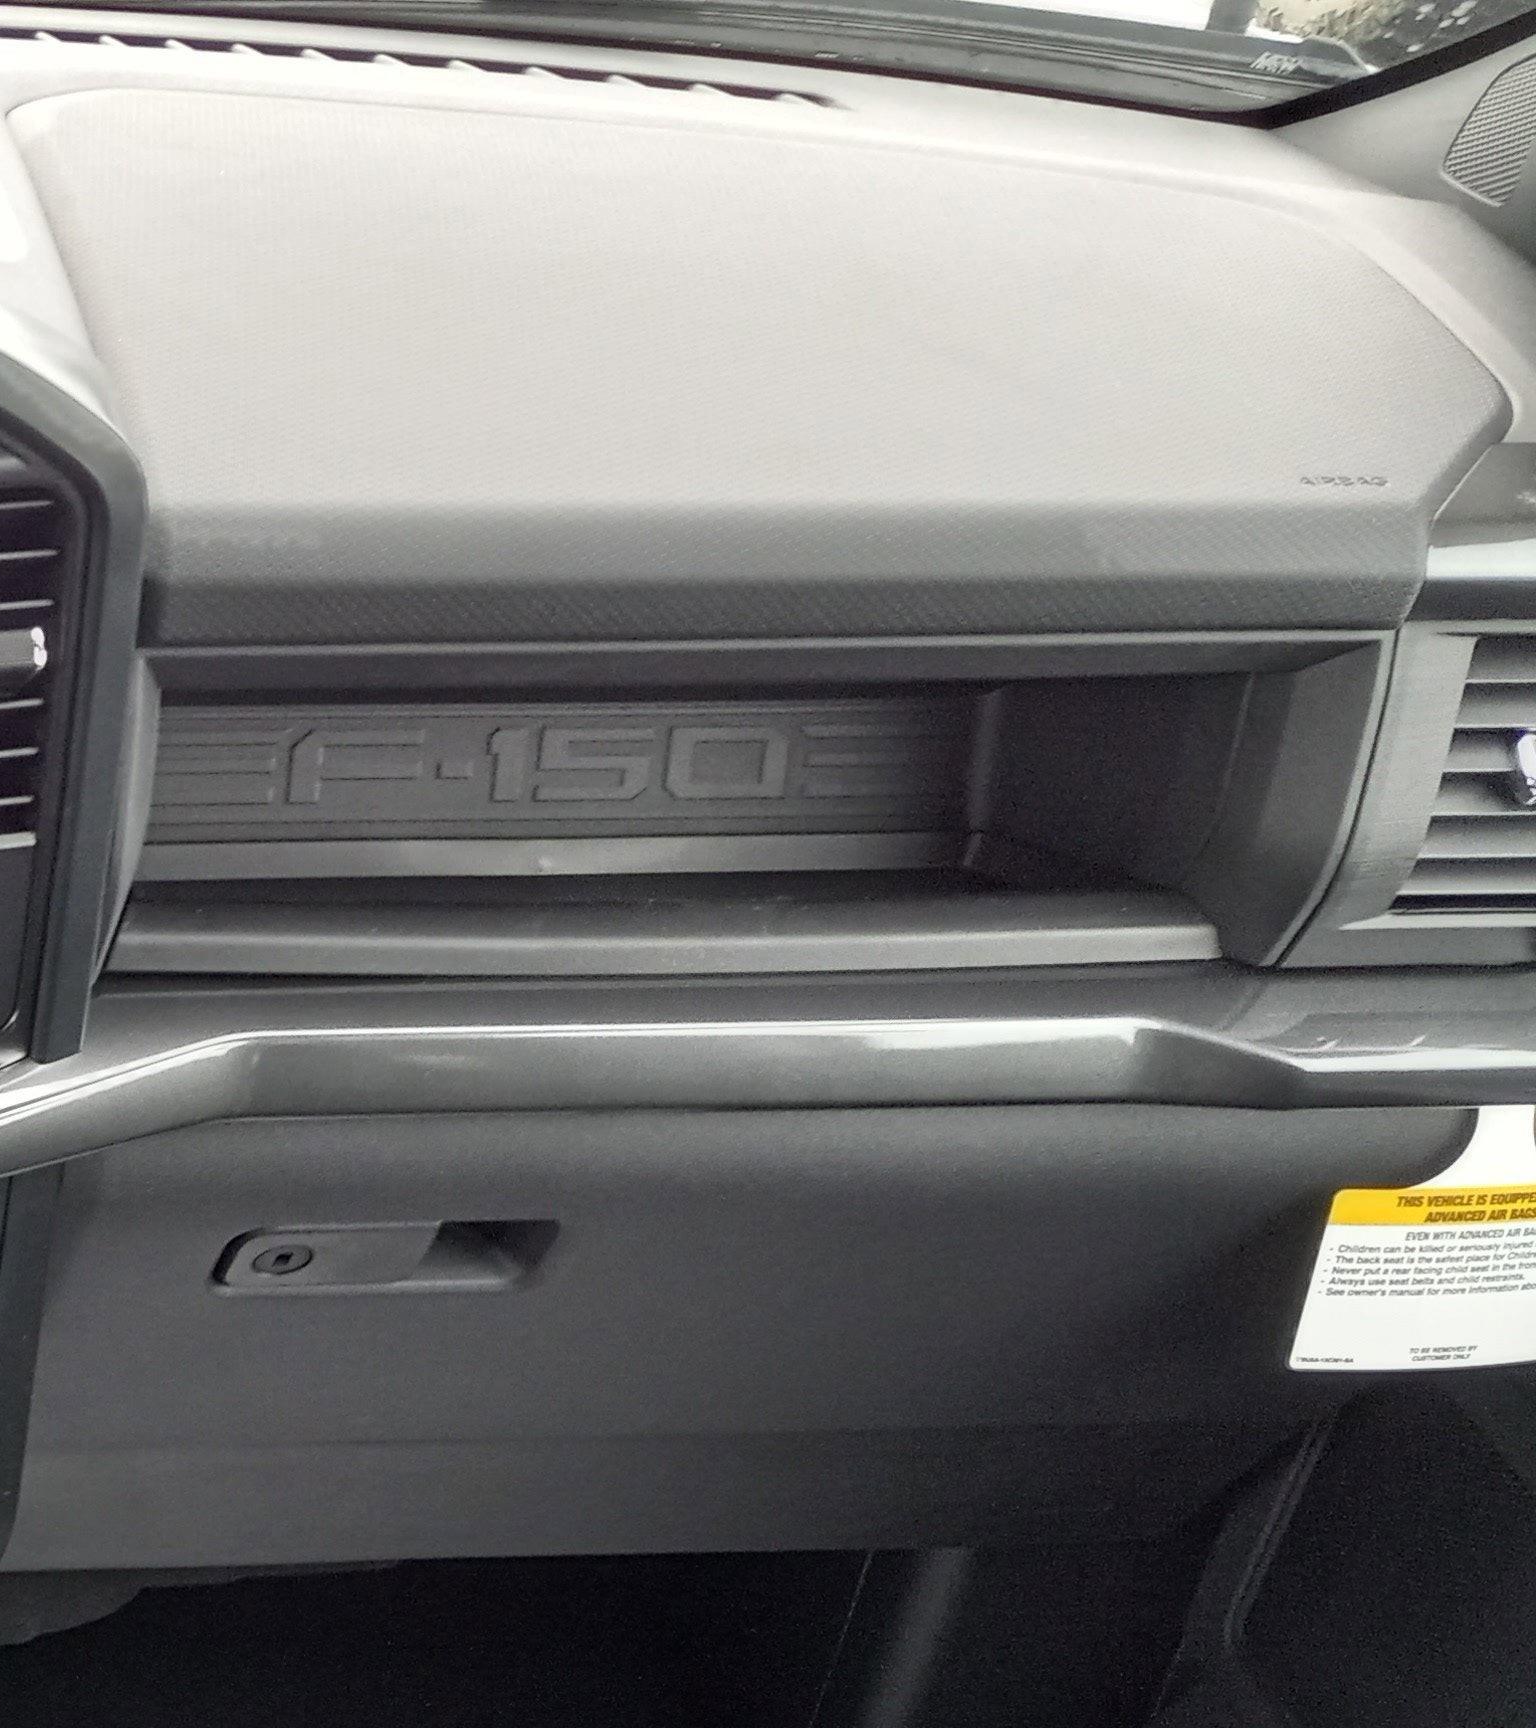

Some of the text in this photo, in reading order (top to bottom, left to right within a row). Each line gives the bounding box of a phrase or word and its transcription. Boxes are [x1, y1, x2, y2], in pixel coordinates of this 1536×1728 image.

[285, 725, 790, 804] F-150
[1397, 1196, 1425, 1207] THIS
[1426, 1194, 1475, 1207] VEHICLE
[1475, 1193, 1488, 1205] IS
[1424, 1210, 1487, 1223] ADVANCED
[1487, 1209, 1507, 1221] AIR
[1405, 1231, 1430, 1241] EVEN
[1432, 1230, 1458, 1240] WITH
[1458, 1229, 1505, 1239] ADVANCED
[1506, 1228, 1521, 1237] AIR
[1338, 1244, 1381, 1253] Children
[1404, 1245, 1416, 1253] be
[1336, 1255, 1354, 1264] The
[1356, 1256, 1380, 1264] back
[1382, 1256, 1405, 1264] seat
[1417, 1256, 1433, 1264] the
[1465, 1254, 1490, 1263] place
[1492, 1253, 1506, 1261] for
[1331, 1266, 1362, 1275] Never
[1363, 1267, 1382, 1277] put
[1413, 1266, 1443, 1276] facing
[1445, 1265, 1469, 1274] child
[1470, 1265, 1490, 1273] seat
[1502, 1263, 1516, 1271] the
[1328, 1277, 1365, 1287] Always
[1367, 1278, 1387, 1286] use
[1388, 1278, 1410, 1286] seat
[1411, 1277, 1434, 1285] belts
[1437, 1277, 1456, 1285] and
[1457, 1275, 1481, 1284] child
[1325, 1287, 1345, 1296] See
[1347, 1288, 1387, 1297] owner's
[1388, 1288, 1425, 1296] manual
[1442, 1287, 1467, 1295] more
